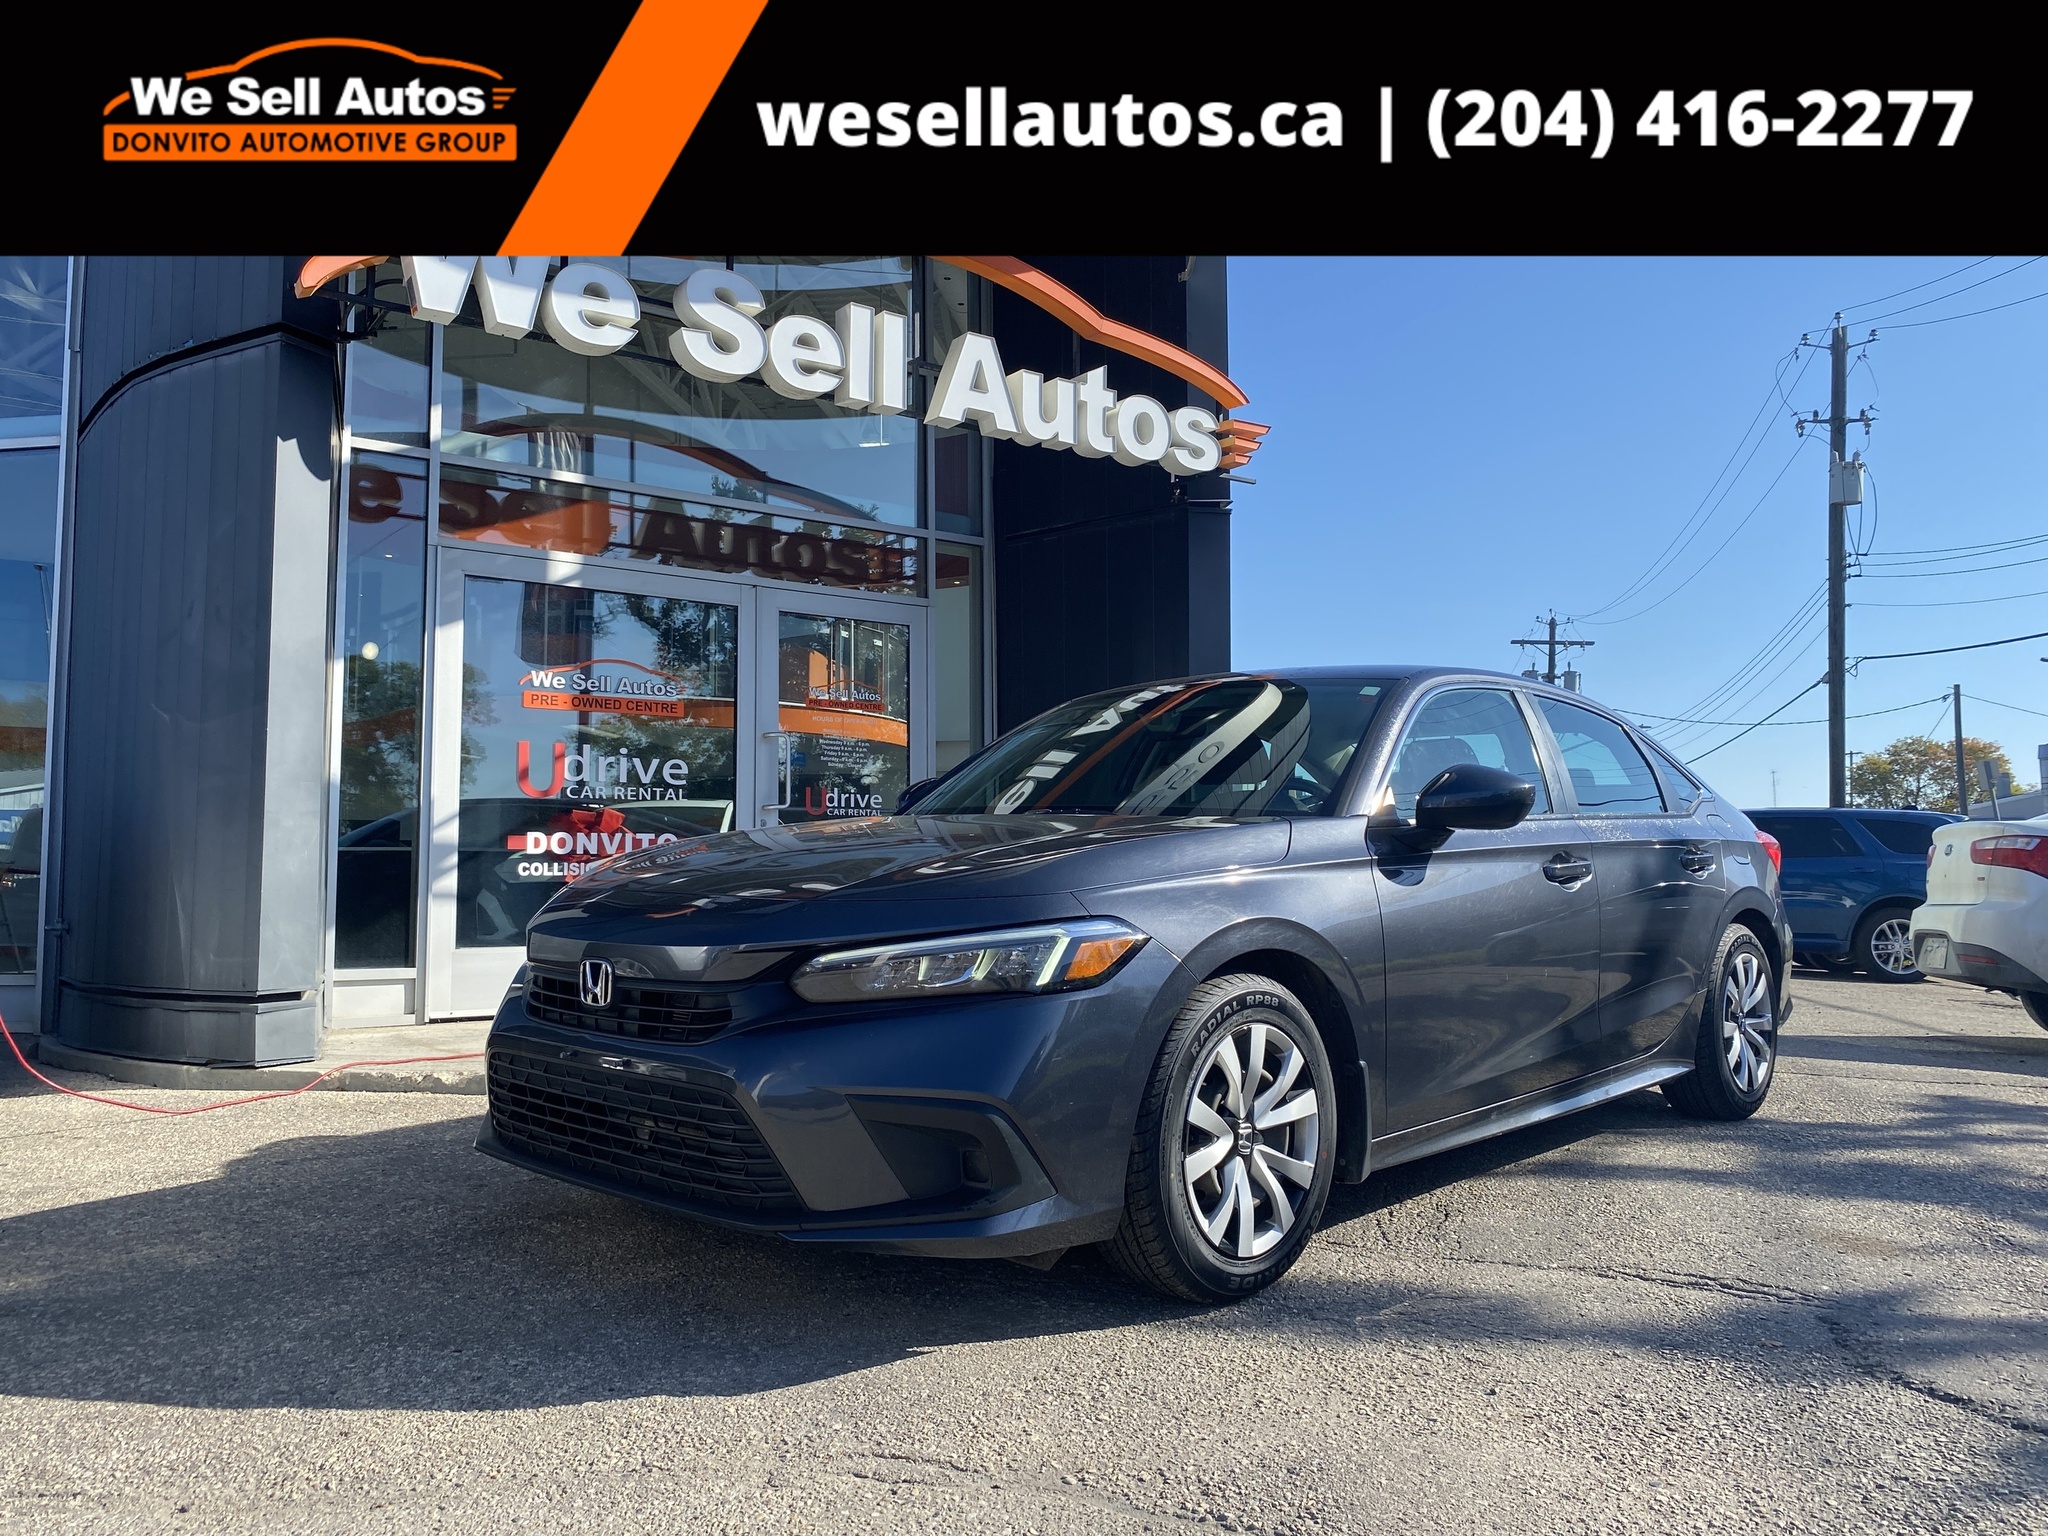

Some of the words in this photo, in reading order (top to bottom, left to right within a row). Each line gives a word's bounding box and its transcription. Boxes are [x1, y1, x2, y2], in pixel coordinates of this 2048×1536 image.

[400, 255, 641, 356] We
[669, 268, 907, 415] Sell
[923, 330, 1222, 476] Autos
[530, 669, 566, 689] We
[571, 673, 612, 692] Sell
[616, 677, 678, 697] Autos
[829, 688, 848, 698] Sell
[851, 690, 881, 701] Autos
[530, 693, 559, 706] PRE
[571, 696, 622, 711] OWNED
[626, 700, 678, 714] CENTRE
[829, 700, 854, 708] OWNED
[855, 703, 882, 711] CENTRE
[516, 740, 689, 798] Udrive
[566, 785, 607, 800] CAR
[614, 786, 688, 801] RENTAL
[805, 786, 882, 815] Udrive
[848, 809, 882, 817] RENTAL
[1190, 1000, 1242, 1058] RADIAL
[1246, 994, 1279, 1007] RP88
